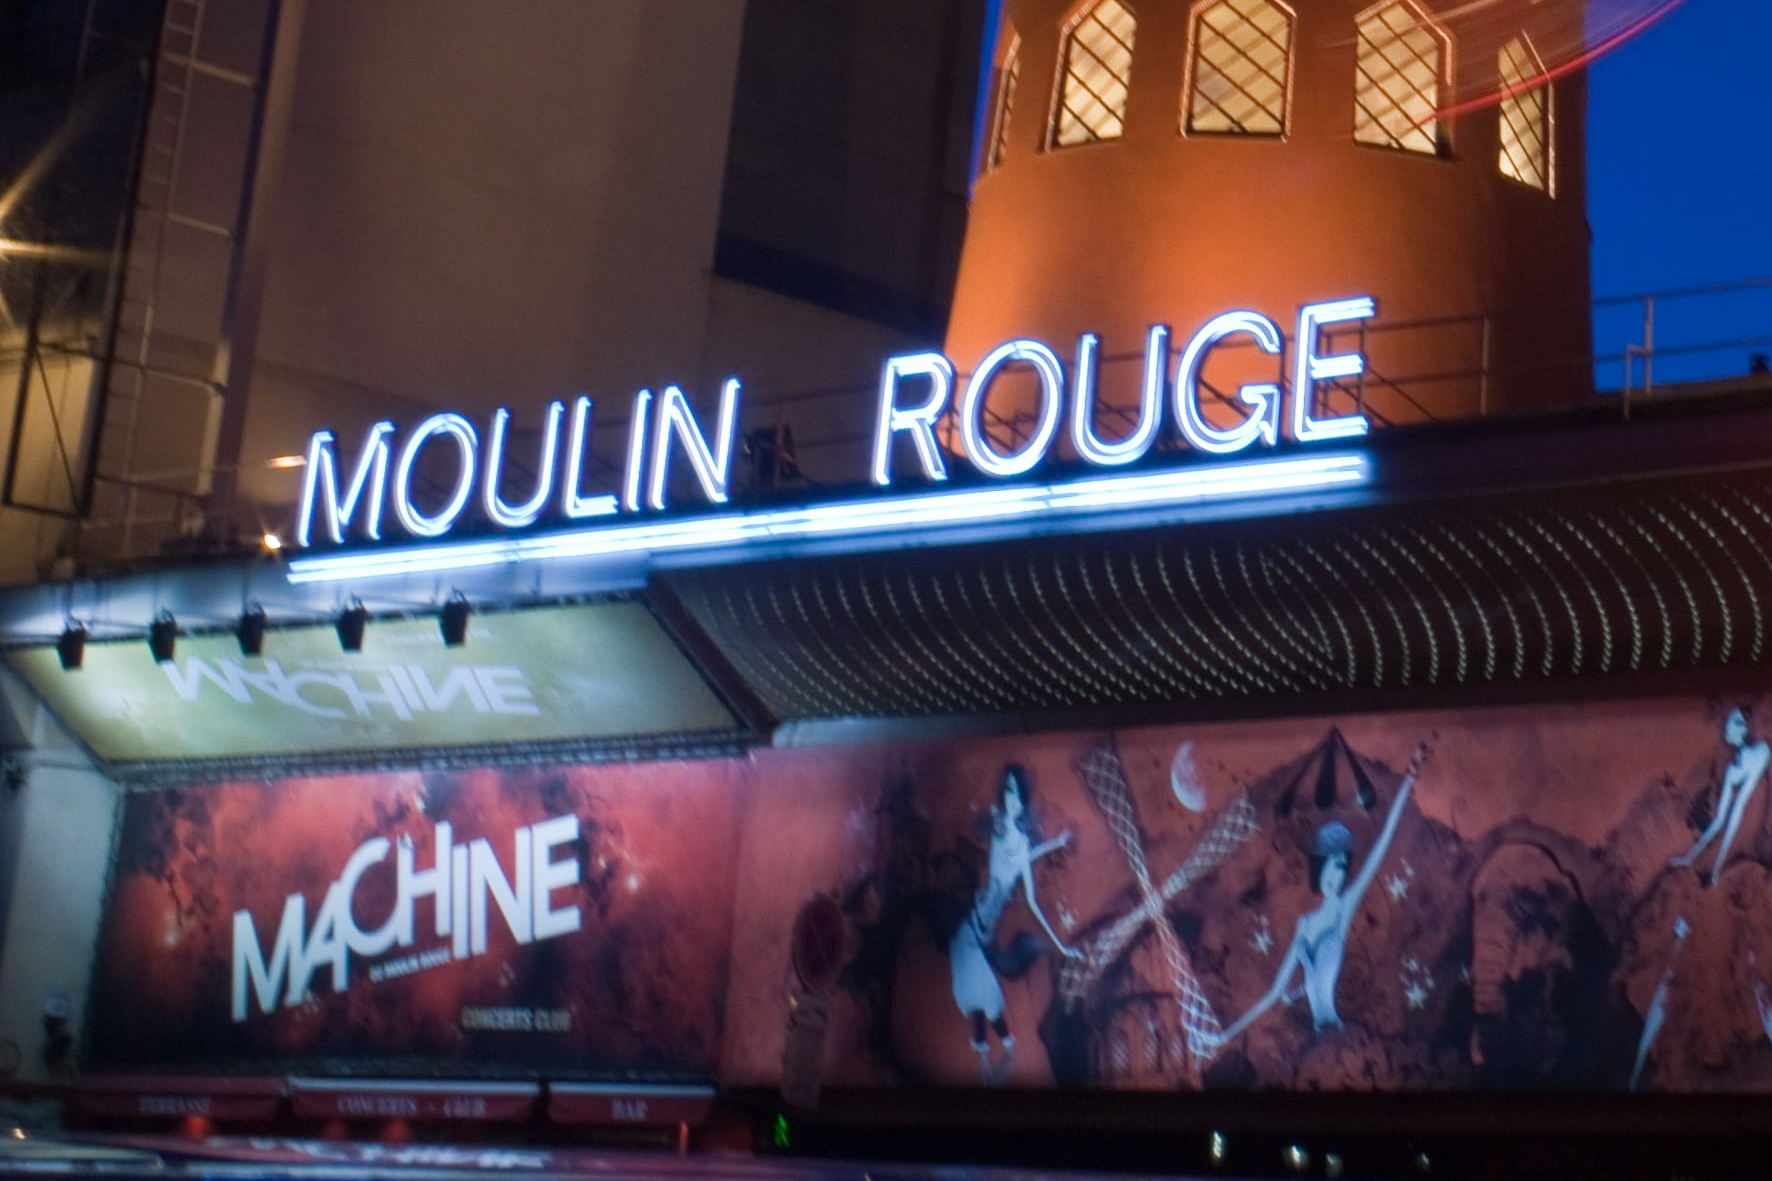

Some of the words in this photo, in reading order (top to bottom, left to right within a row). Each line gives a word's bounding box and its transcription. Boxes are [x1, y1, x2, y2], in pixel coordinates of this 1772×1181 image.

[297, 376, 742, 548] MOULIN
[872, 295, 1376, 486] ROUGE
[231, 813, 581, 1023] MACHINE
[612, 1098, 648, 1120] BAR
